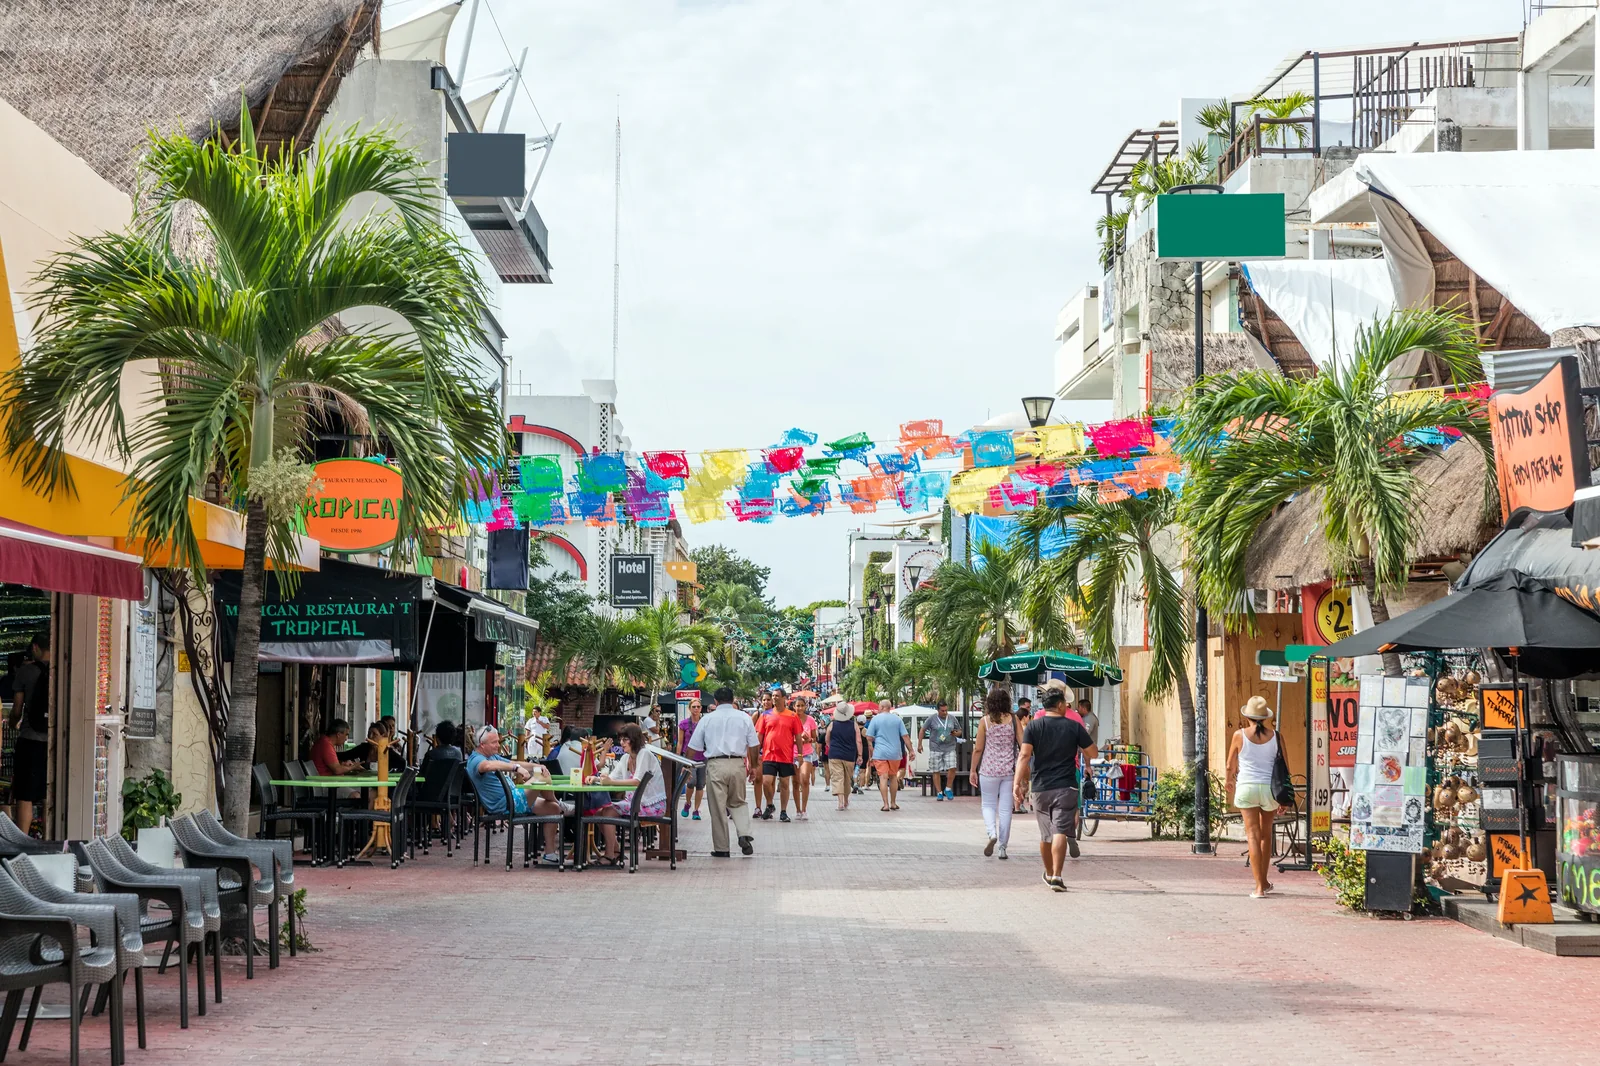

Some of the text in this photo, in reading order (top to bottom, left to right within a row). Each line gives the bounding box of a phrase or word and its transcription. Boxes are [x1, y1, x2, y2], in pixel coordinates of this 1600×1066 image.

[1498, 394, 1562, 450] TATTOO SHOP
[303, 496, 403, 520] ROPICA
[618, 560, 646, 574] Hotel
[226, 604, 300, 617] MICAN
[271, 619, 365, 636] TROPICAL
[1337, 746, 1357, 756] SUB
